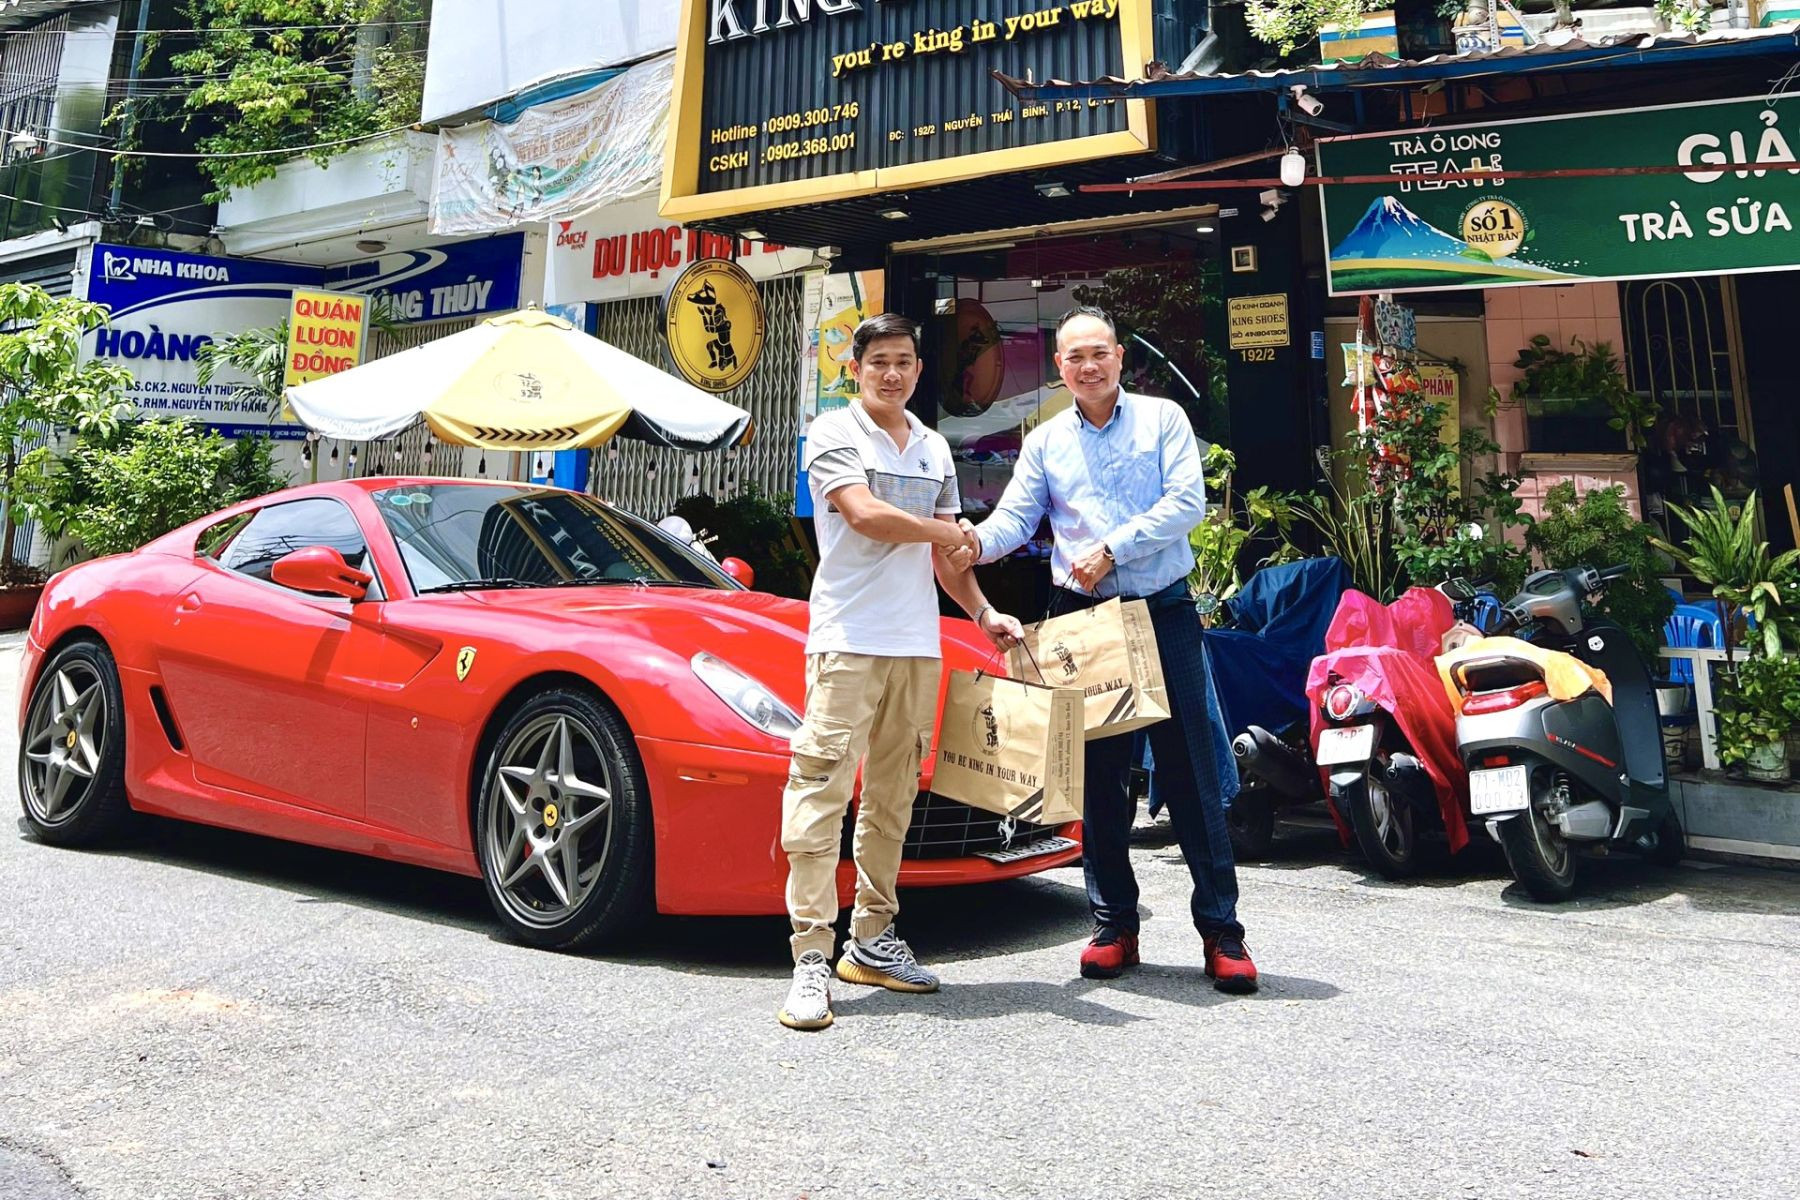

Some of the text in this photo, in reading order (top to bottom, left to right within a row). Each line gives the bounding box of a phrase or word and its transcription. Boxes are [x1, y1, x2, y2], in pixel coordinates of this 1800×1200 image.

[882, 41, 905, 61] re
[913, 25, 964, 55] king
[971, 18, 996, 42] in
[1004, 5, 1063, 40] your
[711, 125, 757, 144] Hotline
[913, 125, 936, 138] 192/2
[944, 114, 983, 132] NGUYỄN
[991, 110, 1014, 123] THÁI
[1389, 132, 1501, 157] TRÀ Ô LONG
[1677, 109, 1800, 183] GIẢ
[710, 151, 749, 172] CSKH
[1470, 207, 1514, 232] SỐ 1
[1618, 197, 1793, 242] TRÀ SỮA
[1467, 230, 1519, 244] NHẬT BẢN
[592, 234, 628, 279] DU
[629, 225, 683, 279] HỌC
[133, 257, 230, 282] NHA KHOA
[430, 275, 494, 316] THÚY
[1232, 313, 1285, 326] KING SHOES
[295, 325, 356, 349] LƯƠN
[1240, 349, 1276, 362] 192/2
[1423, 369, 1455, 397] PHẨM
[1105, 678, 1123, 692] WAY
[943, 751, 956, 764] YOU
[968, 756, 984, 774] KING
[985, 763, 995, 777] IN
[997, 766, 1017, 782] YOUR
[1020, 772, 1038, 788] WAY
